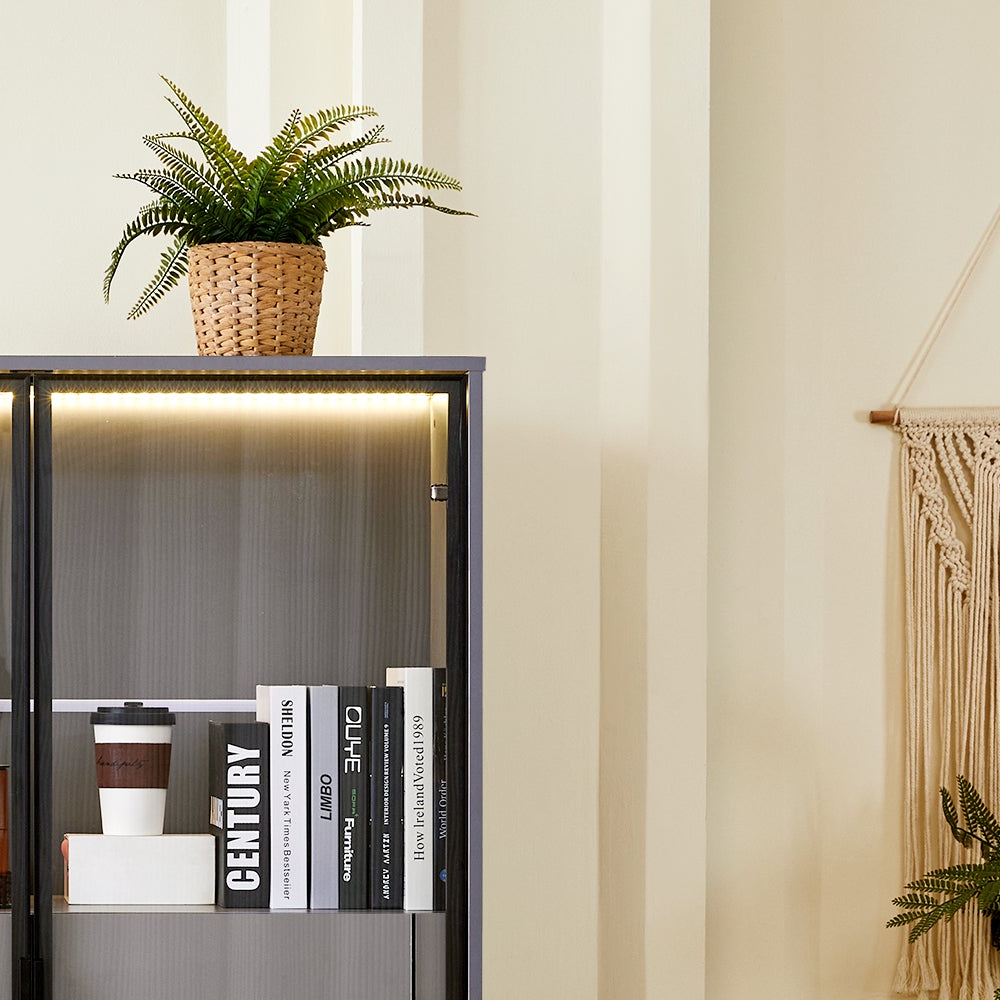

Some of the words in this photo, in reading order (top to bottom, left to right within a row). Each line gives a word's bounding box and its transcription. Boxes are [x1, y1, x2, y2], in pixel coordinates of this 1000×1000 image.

[281, 699, 294, 757] SHELDON
[344, 706, 362, 774] OUYE
[283, 770, 292, 791] New
[320, 774, 333, 821] LIMBO
[438, 779, 448, 808] Order
[225, 743, 261, 891] CENTURY
[283, 818, 292, 848] Times
[438, 811, 448, 839] World
[343, 817, 355, 882] Furniture
[413, 831, 425, 861] How
